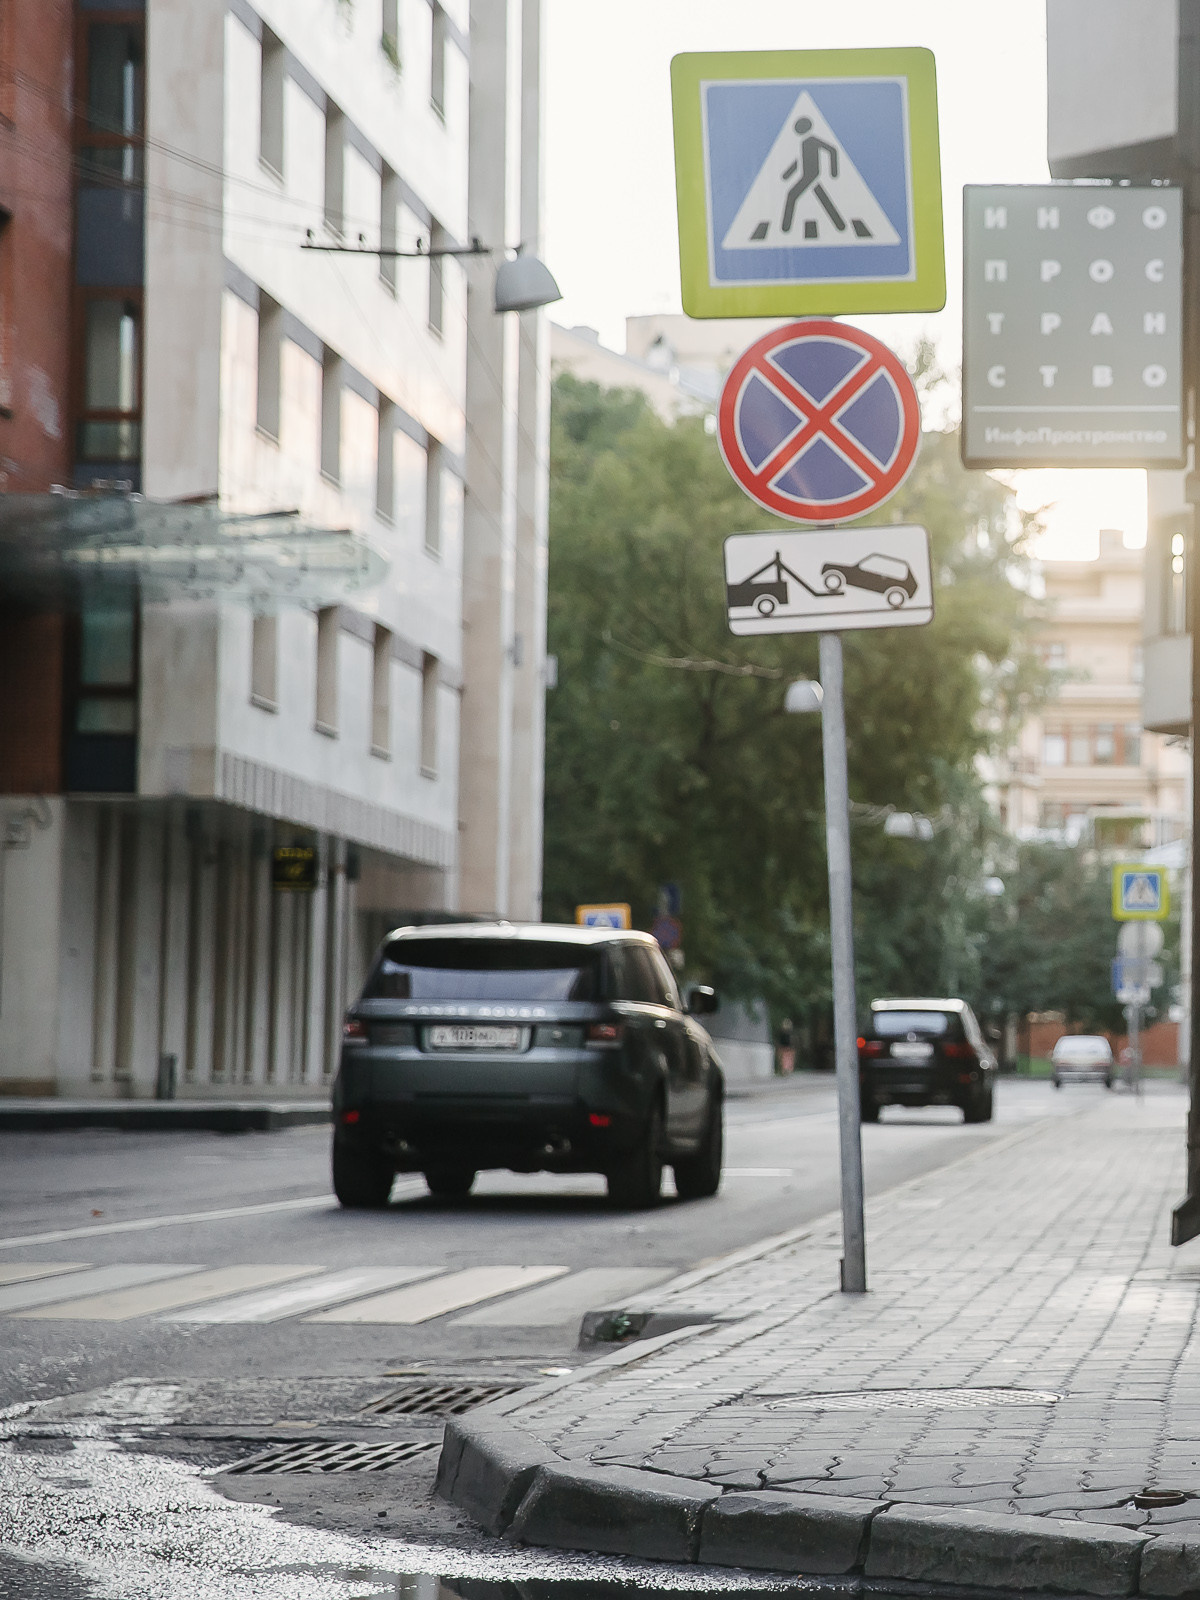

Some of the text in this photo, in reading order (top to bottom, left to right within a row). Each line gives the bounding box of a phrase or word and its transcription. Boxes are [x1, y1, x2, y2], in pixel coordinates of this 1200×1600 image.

[983, 205, 1168, 230] ИНФО
[984, 258, 1165, 283] ПРОС
[985, 312, 1167, 336] ТРАН
[986, 363, 1168, 389] СТВО
